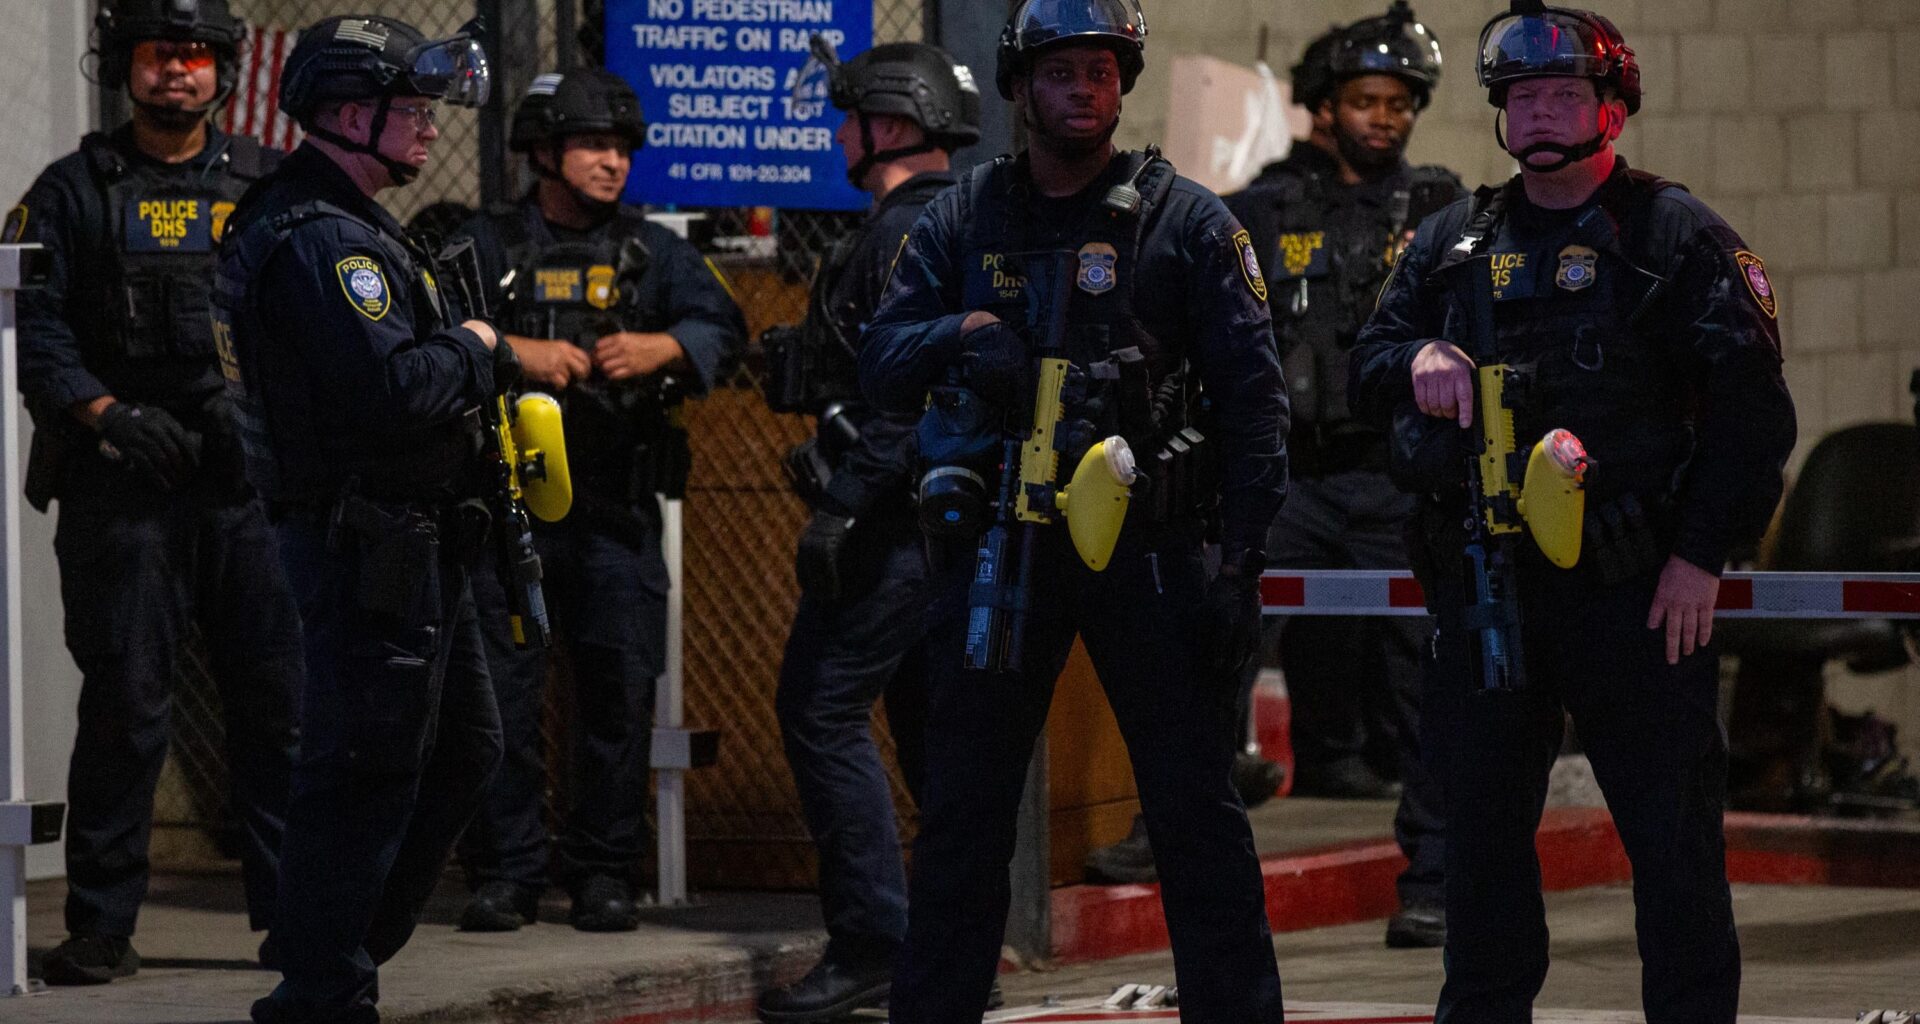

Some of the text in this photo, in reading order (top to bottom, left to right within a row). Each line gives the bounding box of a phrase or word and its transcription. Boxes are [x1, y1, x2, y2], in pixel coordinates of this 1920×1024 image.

[648, 0, 832, 23] NO PEDESTRIAN
[632, 24, 727, 50] TRAFFIC
[736, 27, 771, 51] ON
[650, 64, 775, 90] VIOLATORS
[669, 94, 772, 119] SUBJECT
[647, 123, 831, 151] CITATION UNDER
[668, 163, 811, 183] 41 CFR 101-20.304
[138, 200, 199, 220] POLICE
[151, 219, 187, 238] DHS
[342, 260, 379, 274] POLICE
[1490, 253, 1526, 269] LICE
[1491, 269, 1511, 287] HS
